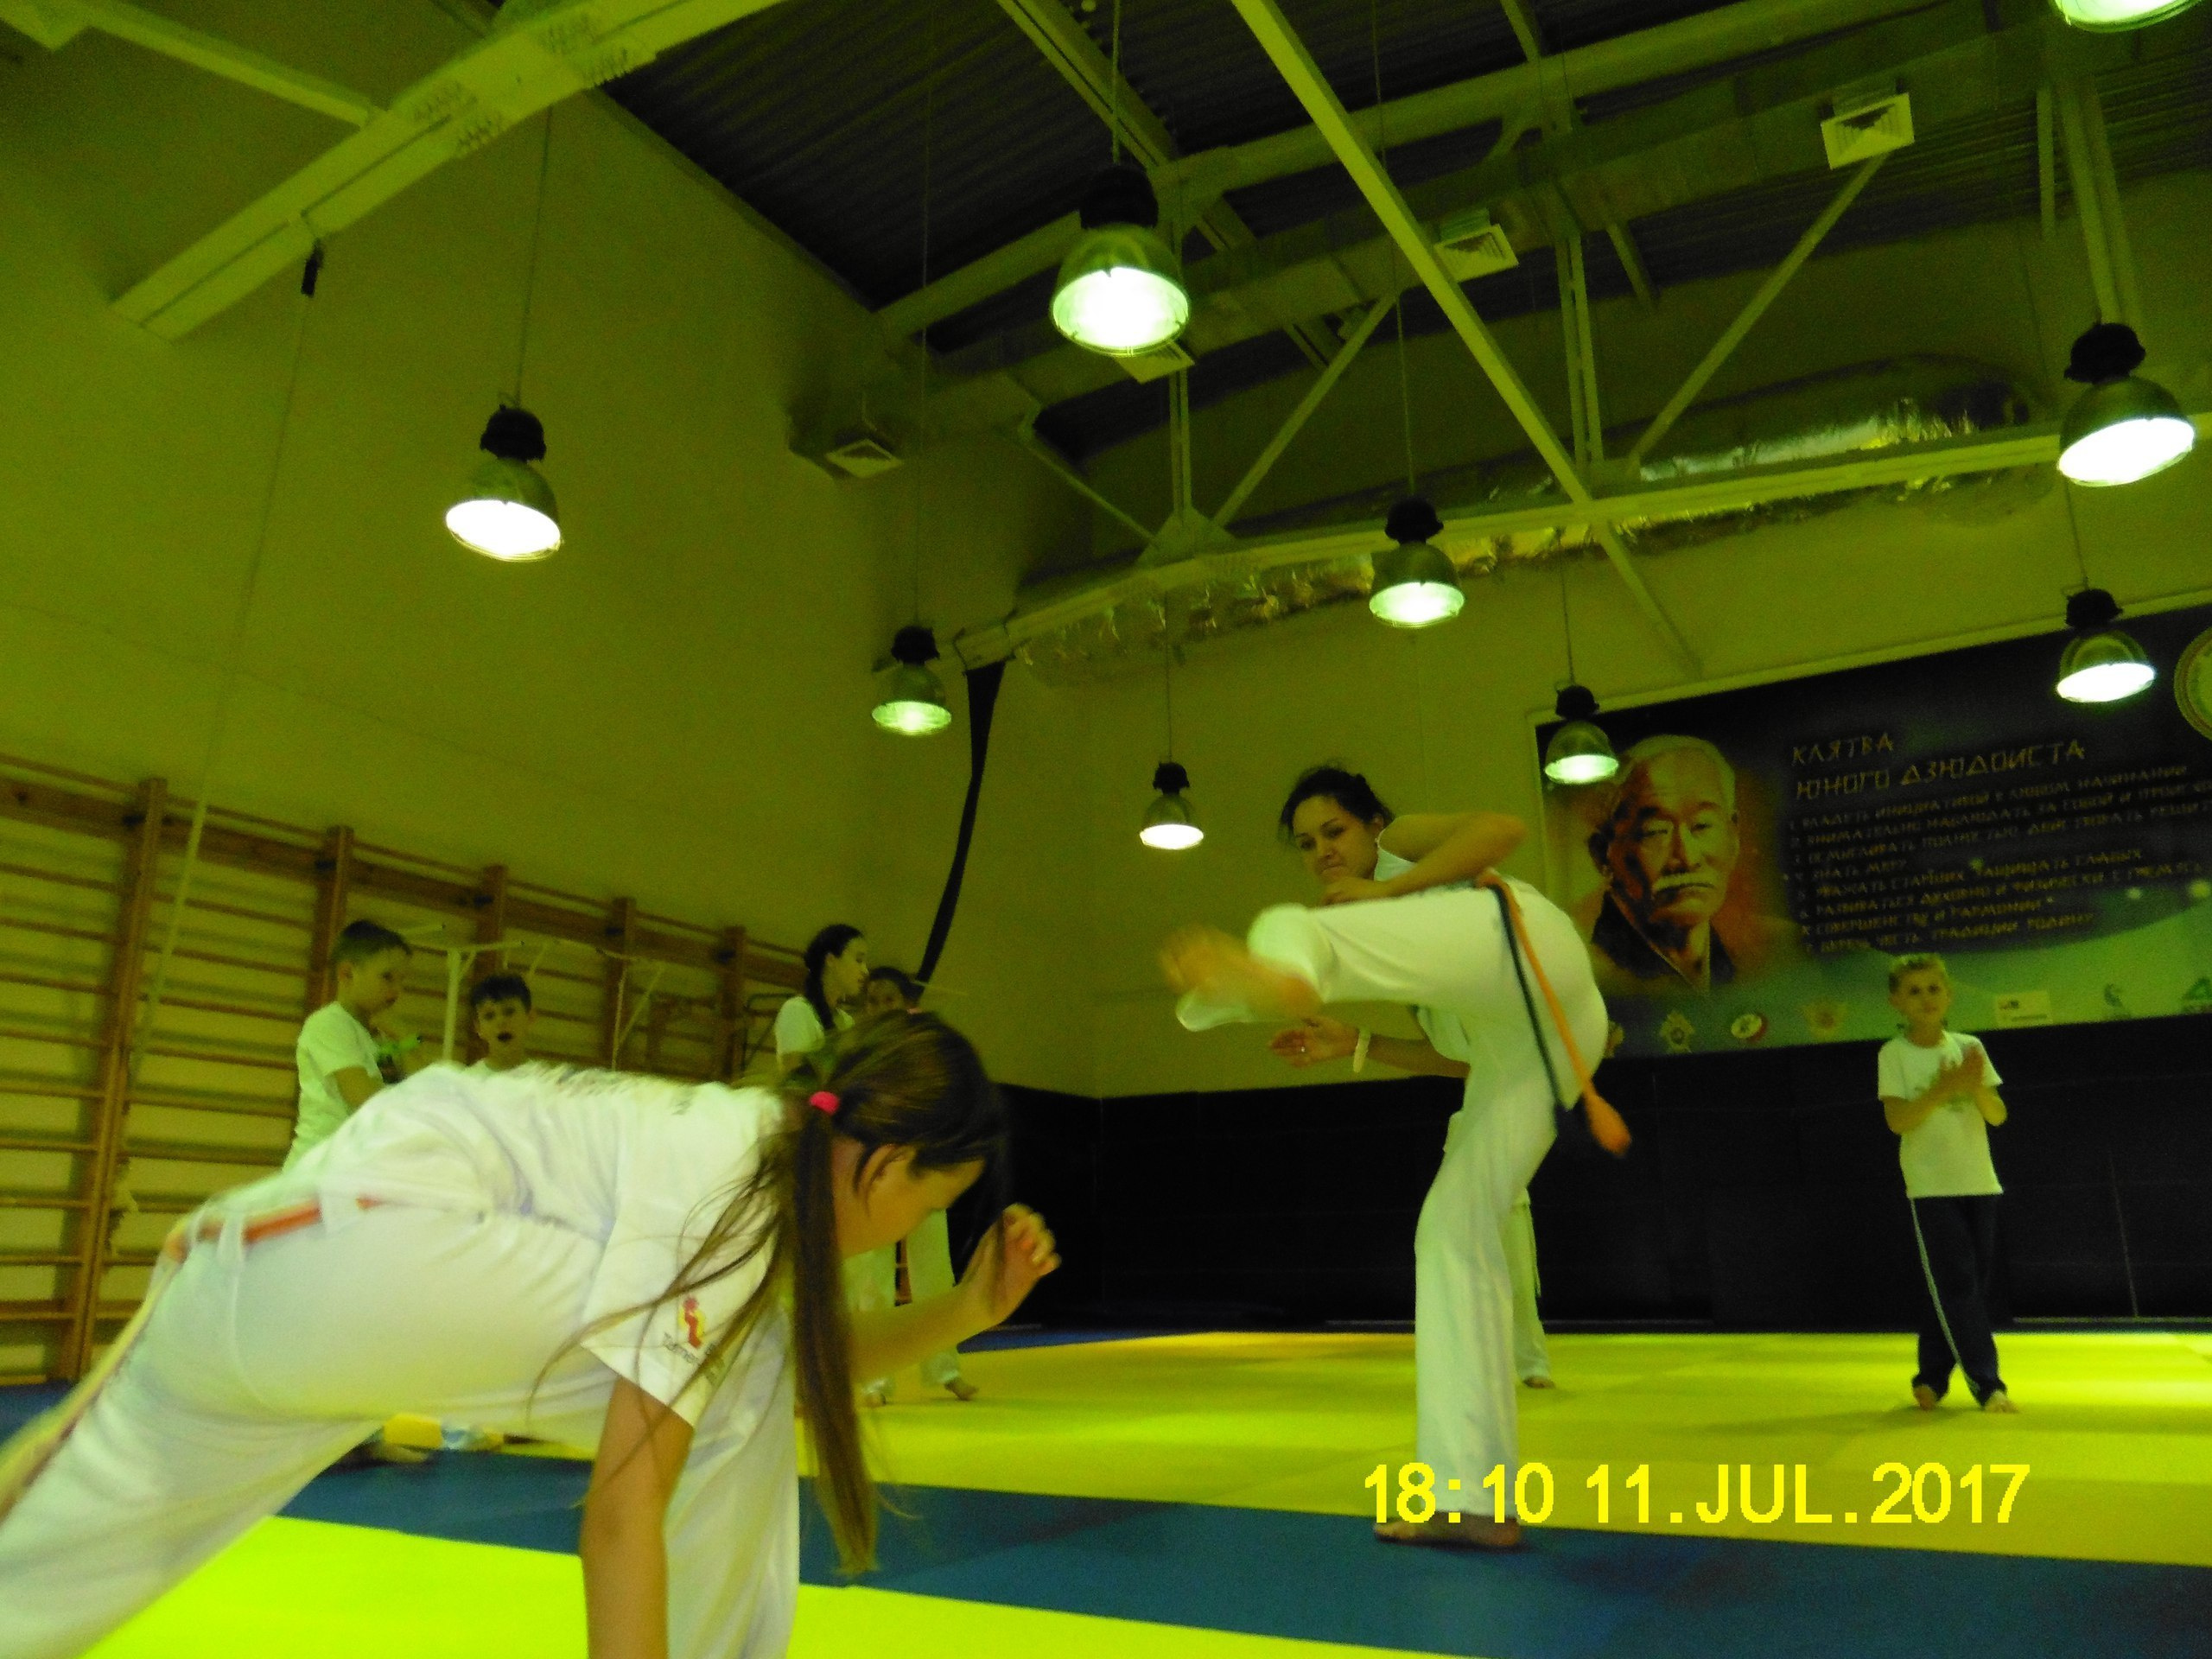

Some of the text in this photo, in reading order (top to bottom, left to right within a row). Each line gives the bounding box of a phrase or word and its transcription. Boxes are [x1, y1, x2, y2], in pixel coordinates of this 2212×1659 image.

[1792, 732, 1894, 767] КЛЯТВА
[1796, 739, 2085, 799] ЮНОГО ДЗЮДОИСТА
